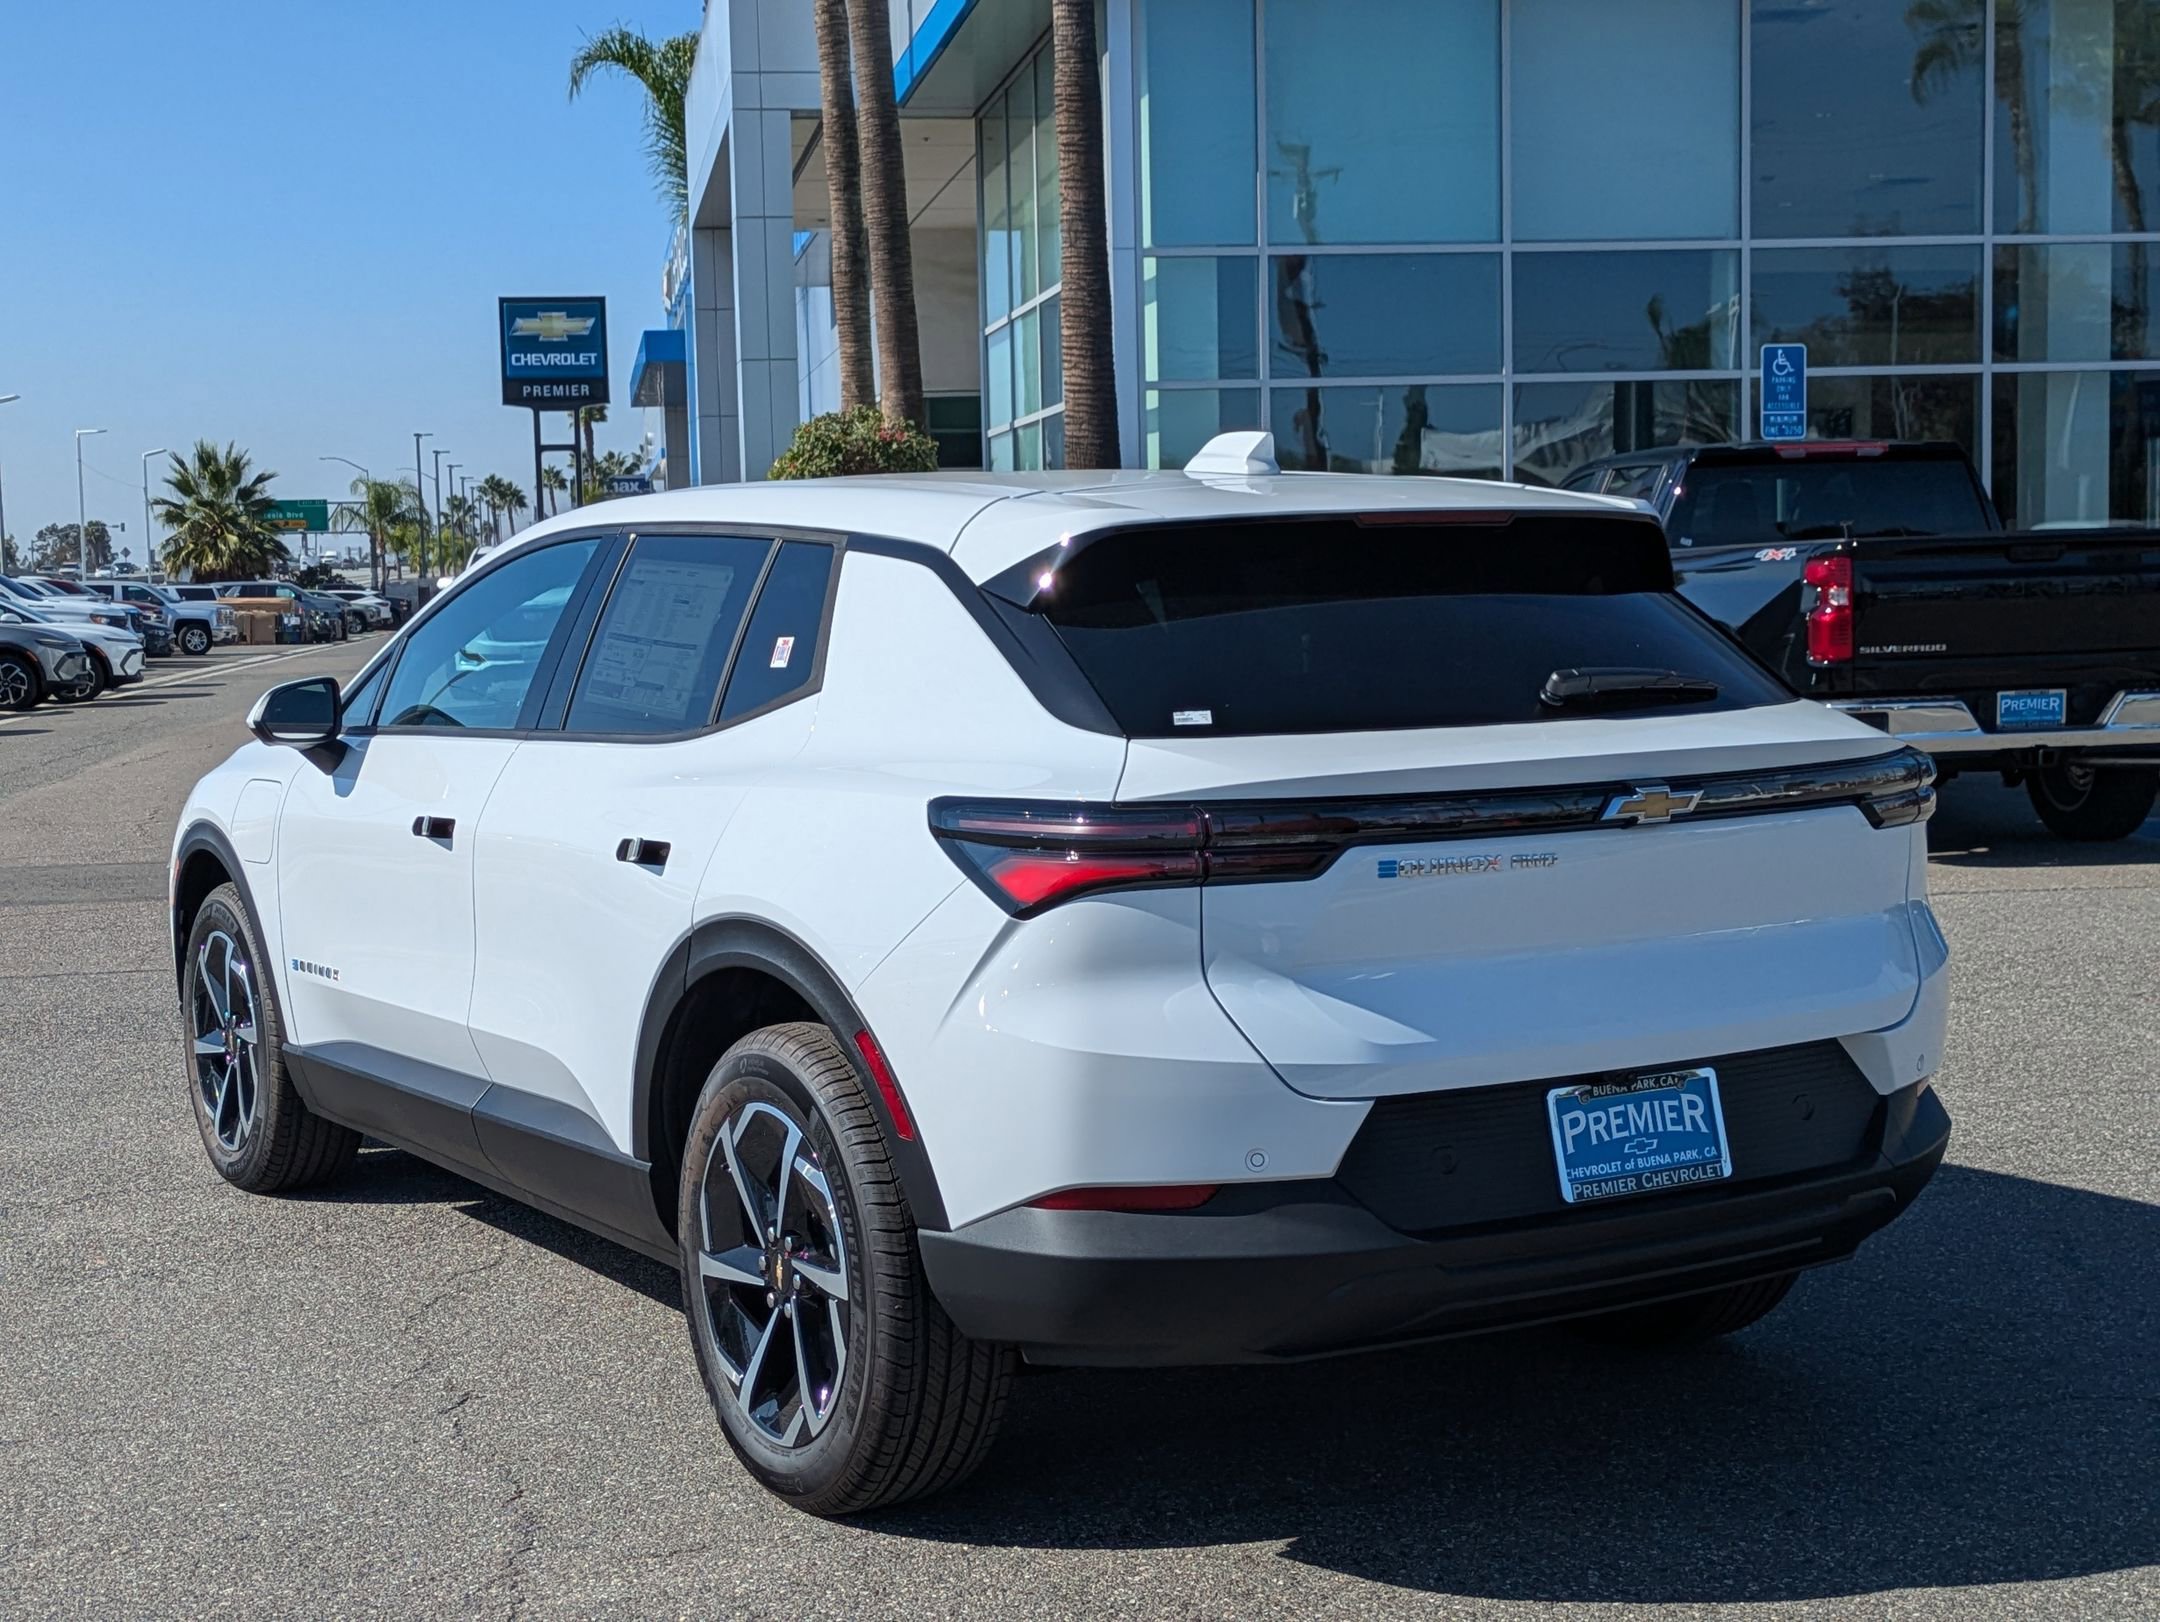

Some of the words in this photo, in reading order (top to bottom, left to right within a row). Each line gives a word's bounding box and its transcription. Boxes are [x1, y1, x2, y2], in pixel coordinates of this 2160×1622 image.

[511, 353, 597, 366] CHEVROLET
[522, 384, 590, 397] PREMIER
[1859, 644, 1947, 654] SILVERADO
[2001, 697, 2060, 714] PREMIER
[1561, 1093, 1710, 1156] PREMIER
[1566, 1161, 1622, 1179] CHEVROLET
[1625, 1158, 1635, 1170] of
[1638, 1152, 1672, 1169] BUENA
[1674, 1149, 1703, 1163] PARK,
[1704, 1146, 1718, 1157] CA
[1573, 1177, 1637, 1199] PREMIER
[1642, 1163, 1722, 1187] CHEVROLET
